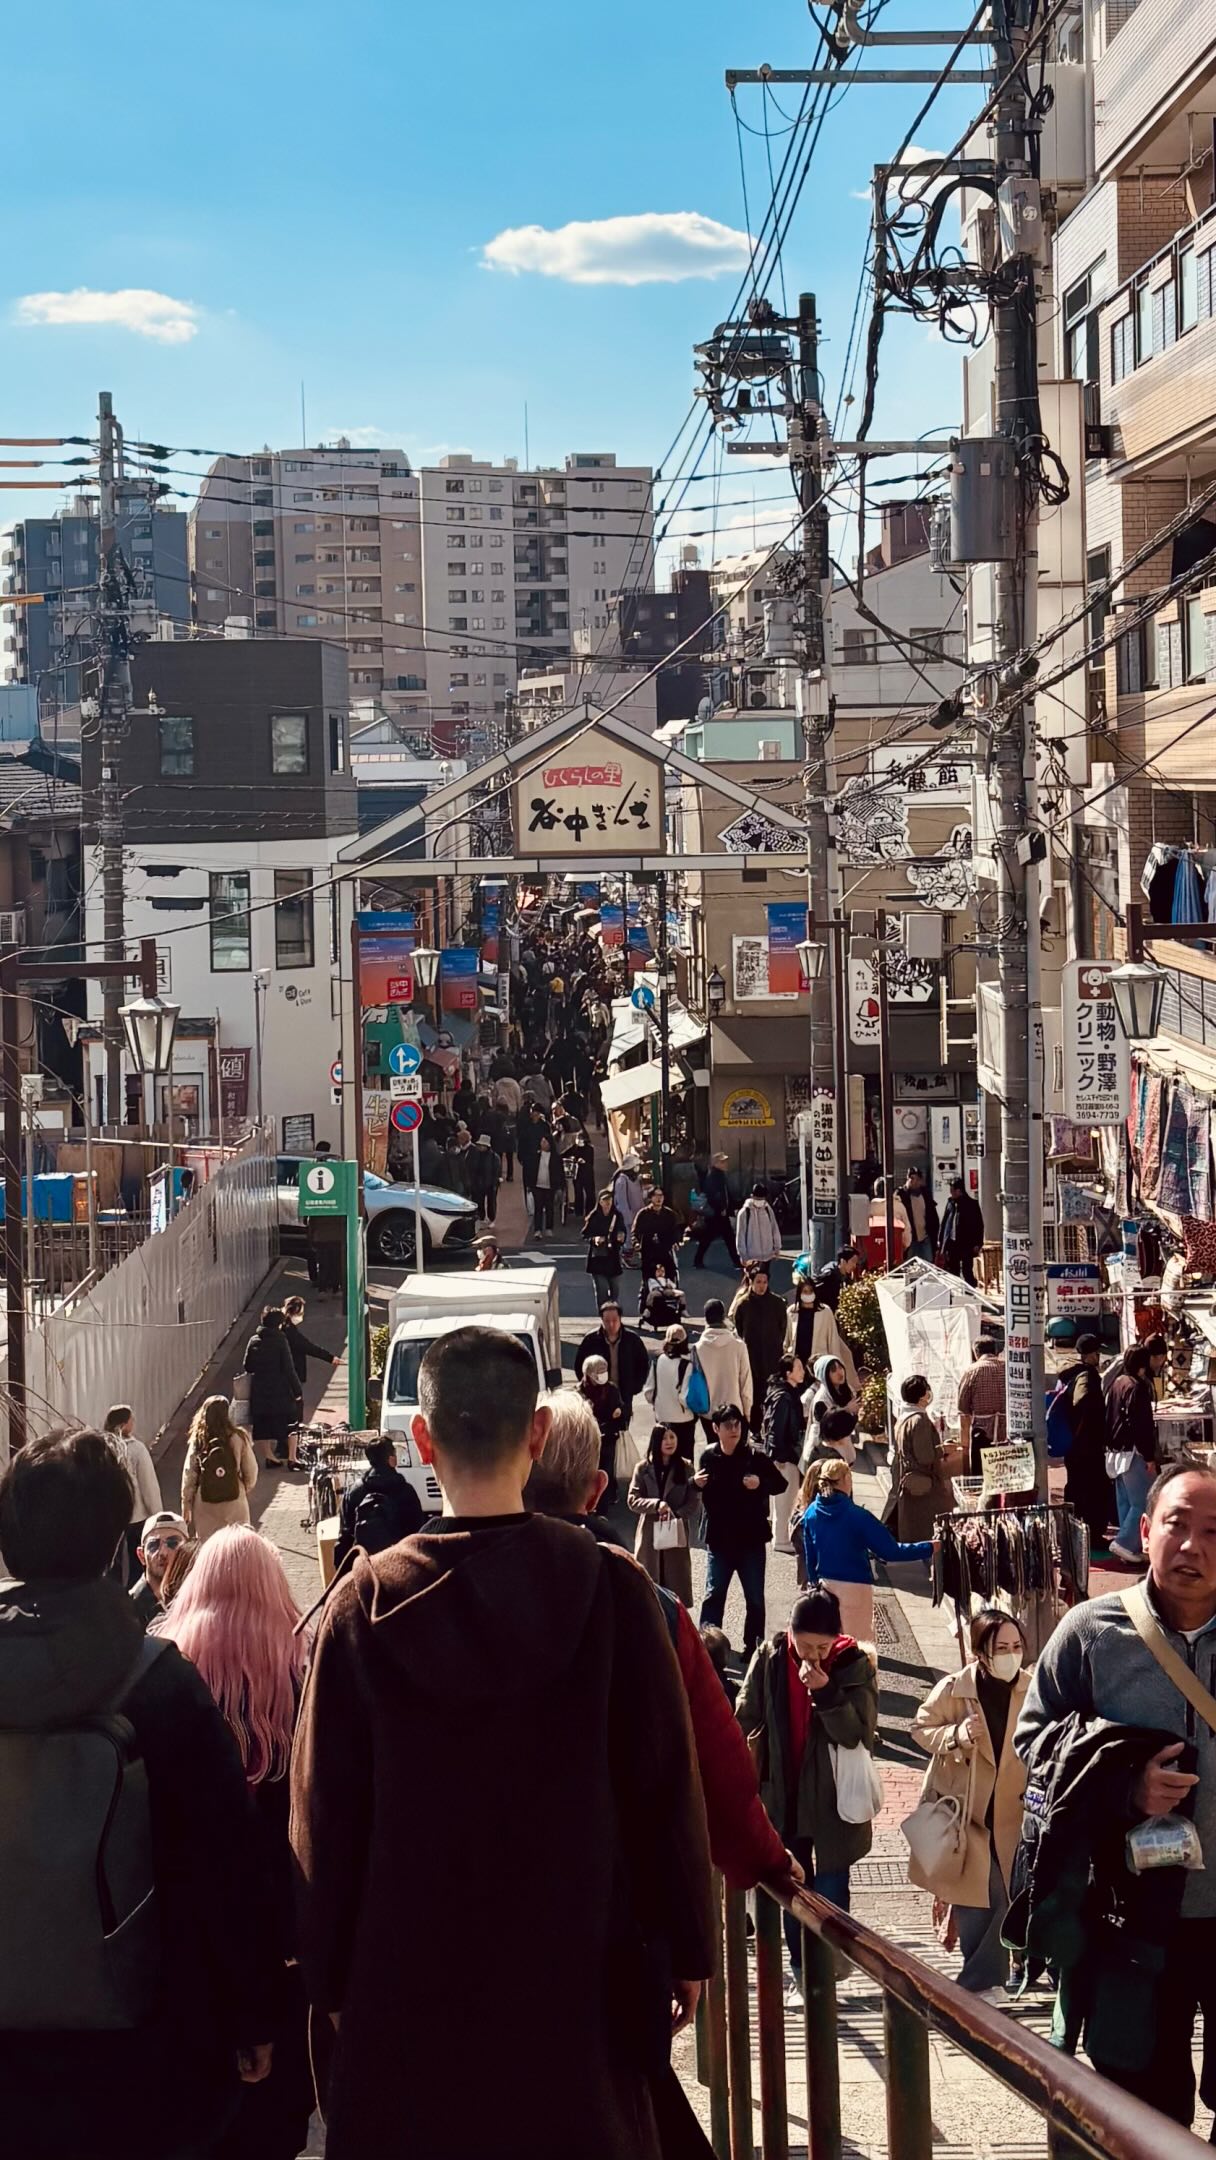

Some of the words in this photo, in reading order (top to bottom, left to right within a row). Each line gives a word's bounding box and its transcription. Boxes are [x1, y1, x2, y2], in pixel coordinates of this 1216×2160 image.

[544, 762, 622, 787] ひぐらしの里
[528, 780, 652, 843] 谷中ぎんざ
[1076, 1003, 1094, 1092] クリニック
[1096, 1002, 1117, 1092] 動物・野澤
[1060, 1267, 1088, 1278] Asahi
